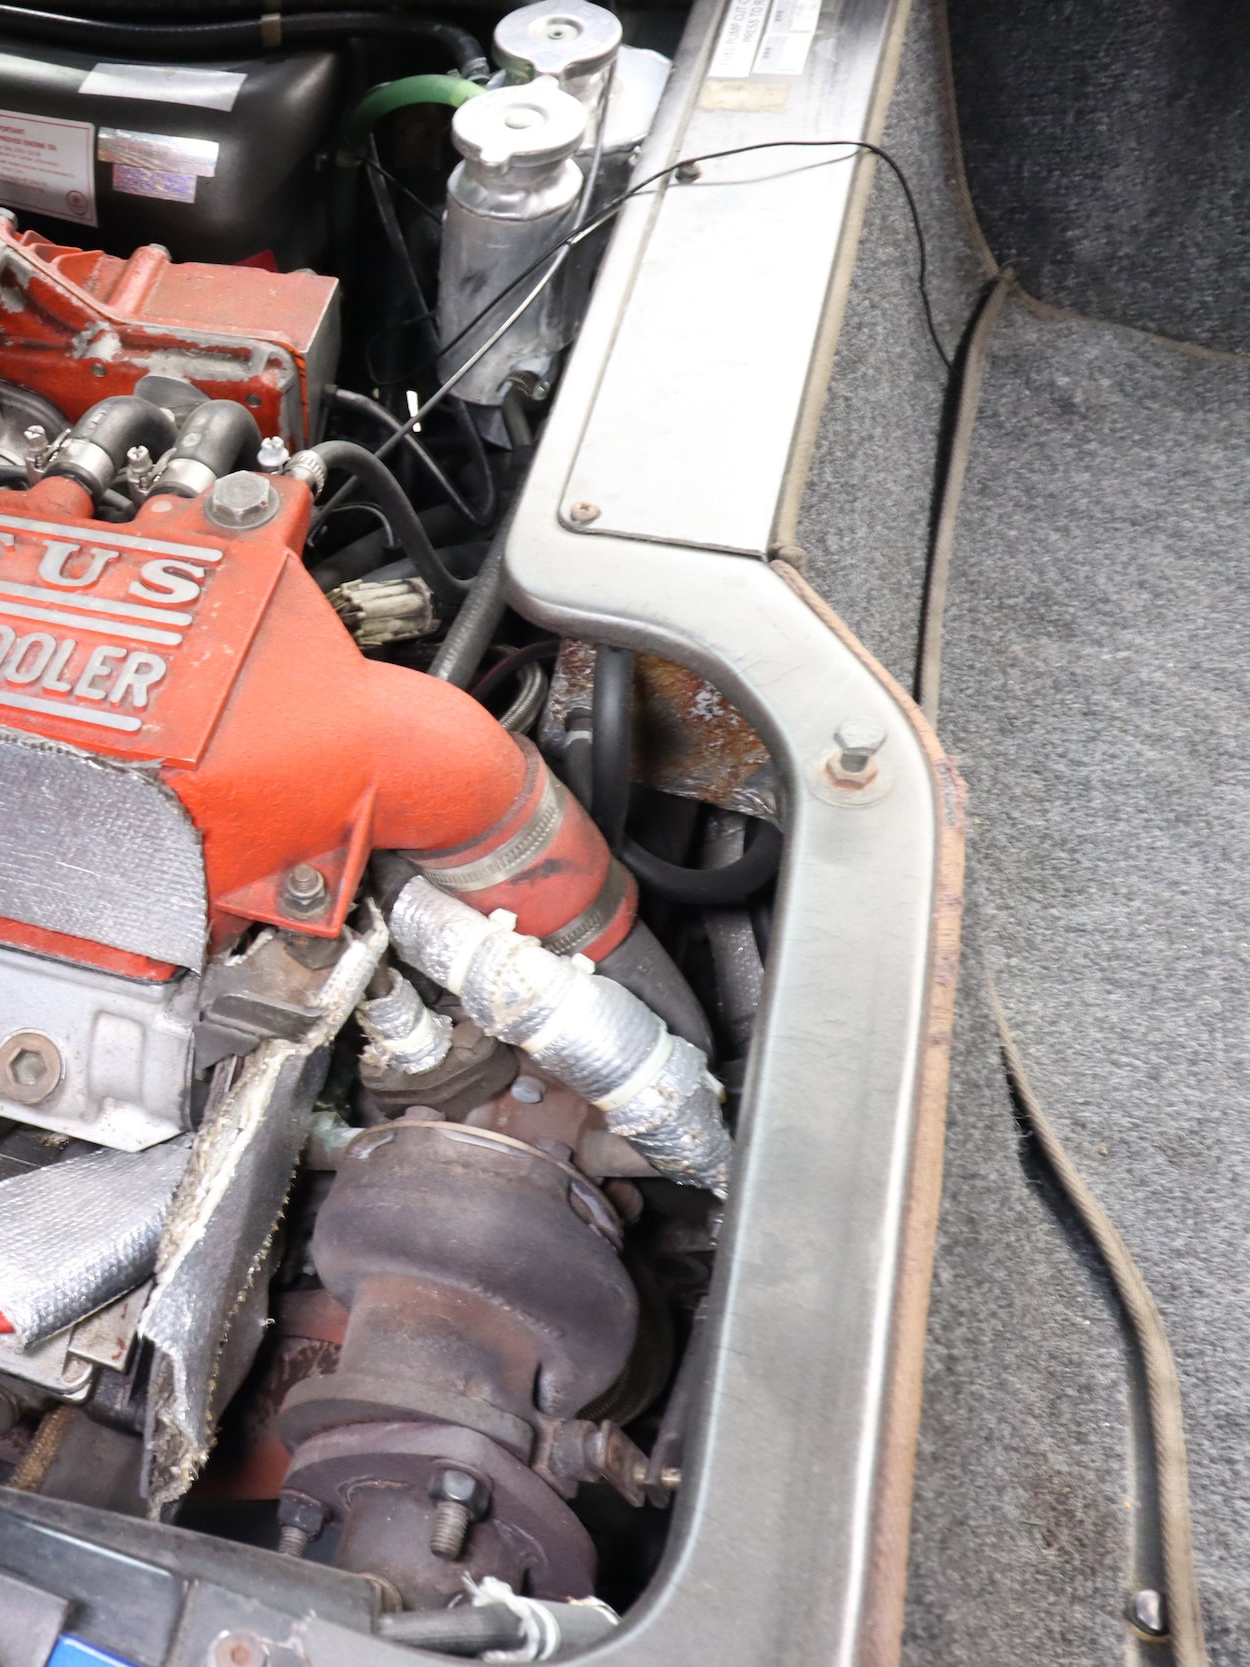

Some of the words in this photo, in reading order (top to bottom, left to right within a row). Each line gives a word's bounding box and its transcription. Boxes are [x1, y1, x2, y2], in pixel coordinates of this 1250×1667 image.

[733, 6, 748, 21] CUT
[750, 6, 764, 17] TO
[725, 22, 742, 44] PUMP
[742, 19, 760, 43] PRESS
